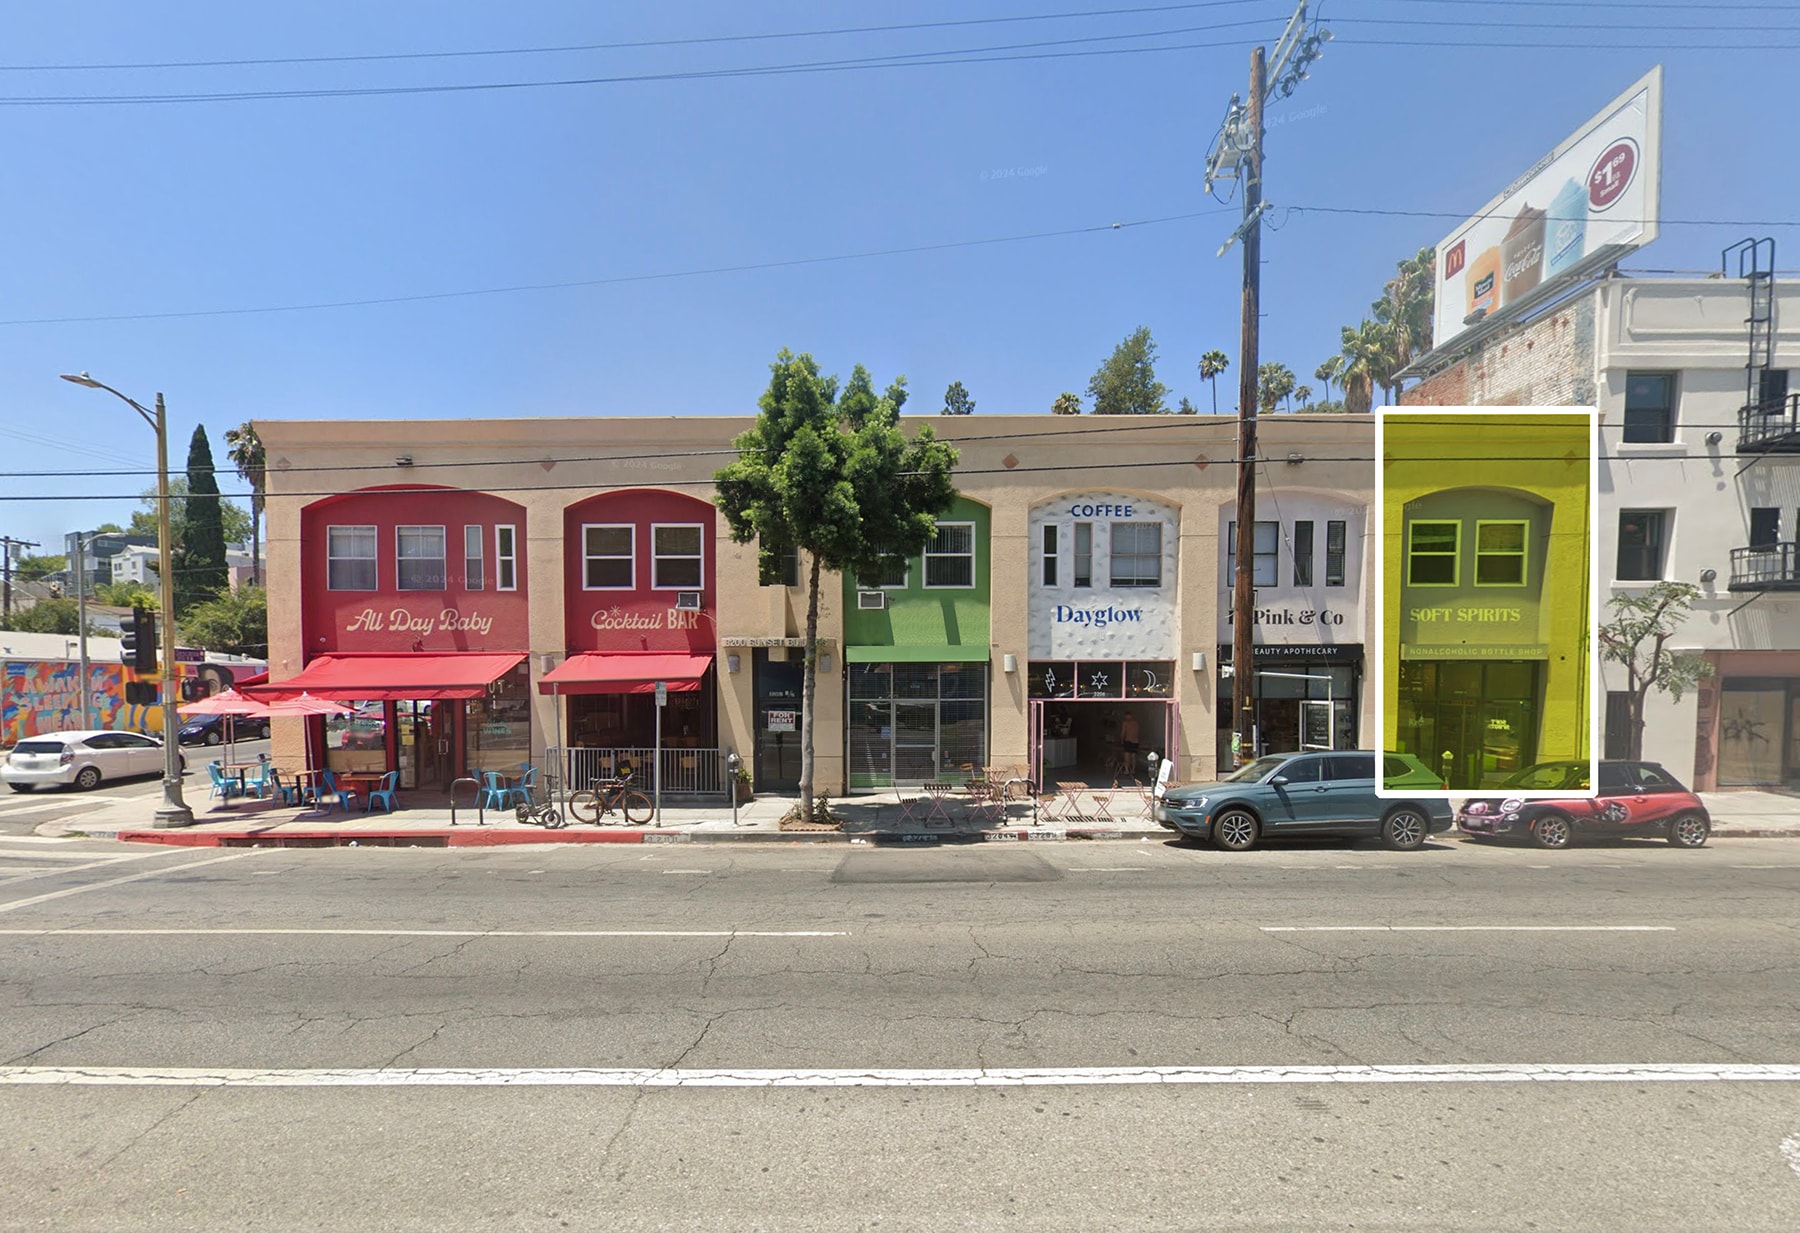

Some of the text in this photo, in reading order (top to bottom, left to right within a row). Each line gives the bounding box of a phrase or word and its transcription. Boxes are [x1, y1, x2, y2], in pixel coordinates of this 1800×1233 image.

[1071, 504, 1133, 517] COFFEE
[346, 607, 493, 636] All Day Baby
[590, 608, 698, 630] Cocktail BAR
[1056, 605, 1143, 627] Dayglow
[1254, 608, 1344, 625] Pink & Co
[1410, 608, 1521, 622] SOFT SPIRITS
[750, 639, 784, 647] SUNSET
[1252, 647, 1338, 655] EAUTY APOTHECARY
[1409, 647, 1543, 656] NONALCOHOLIC BOTTLE SHOP
[22, 675, 104, 695] AWAKN
